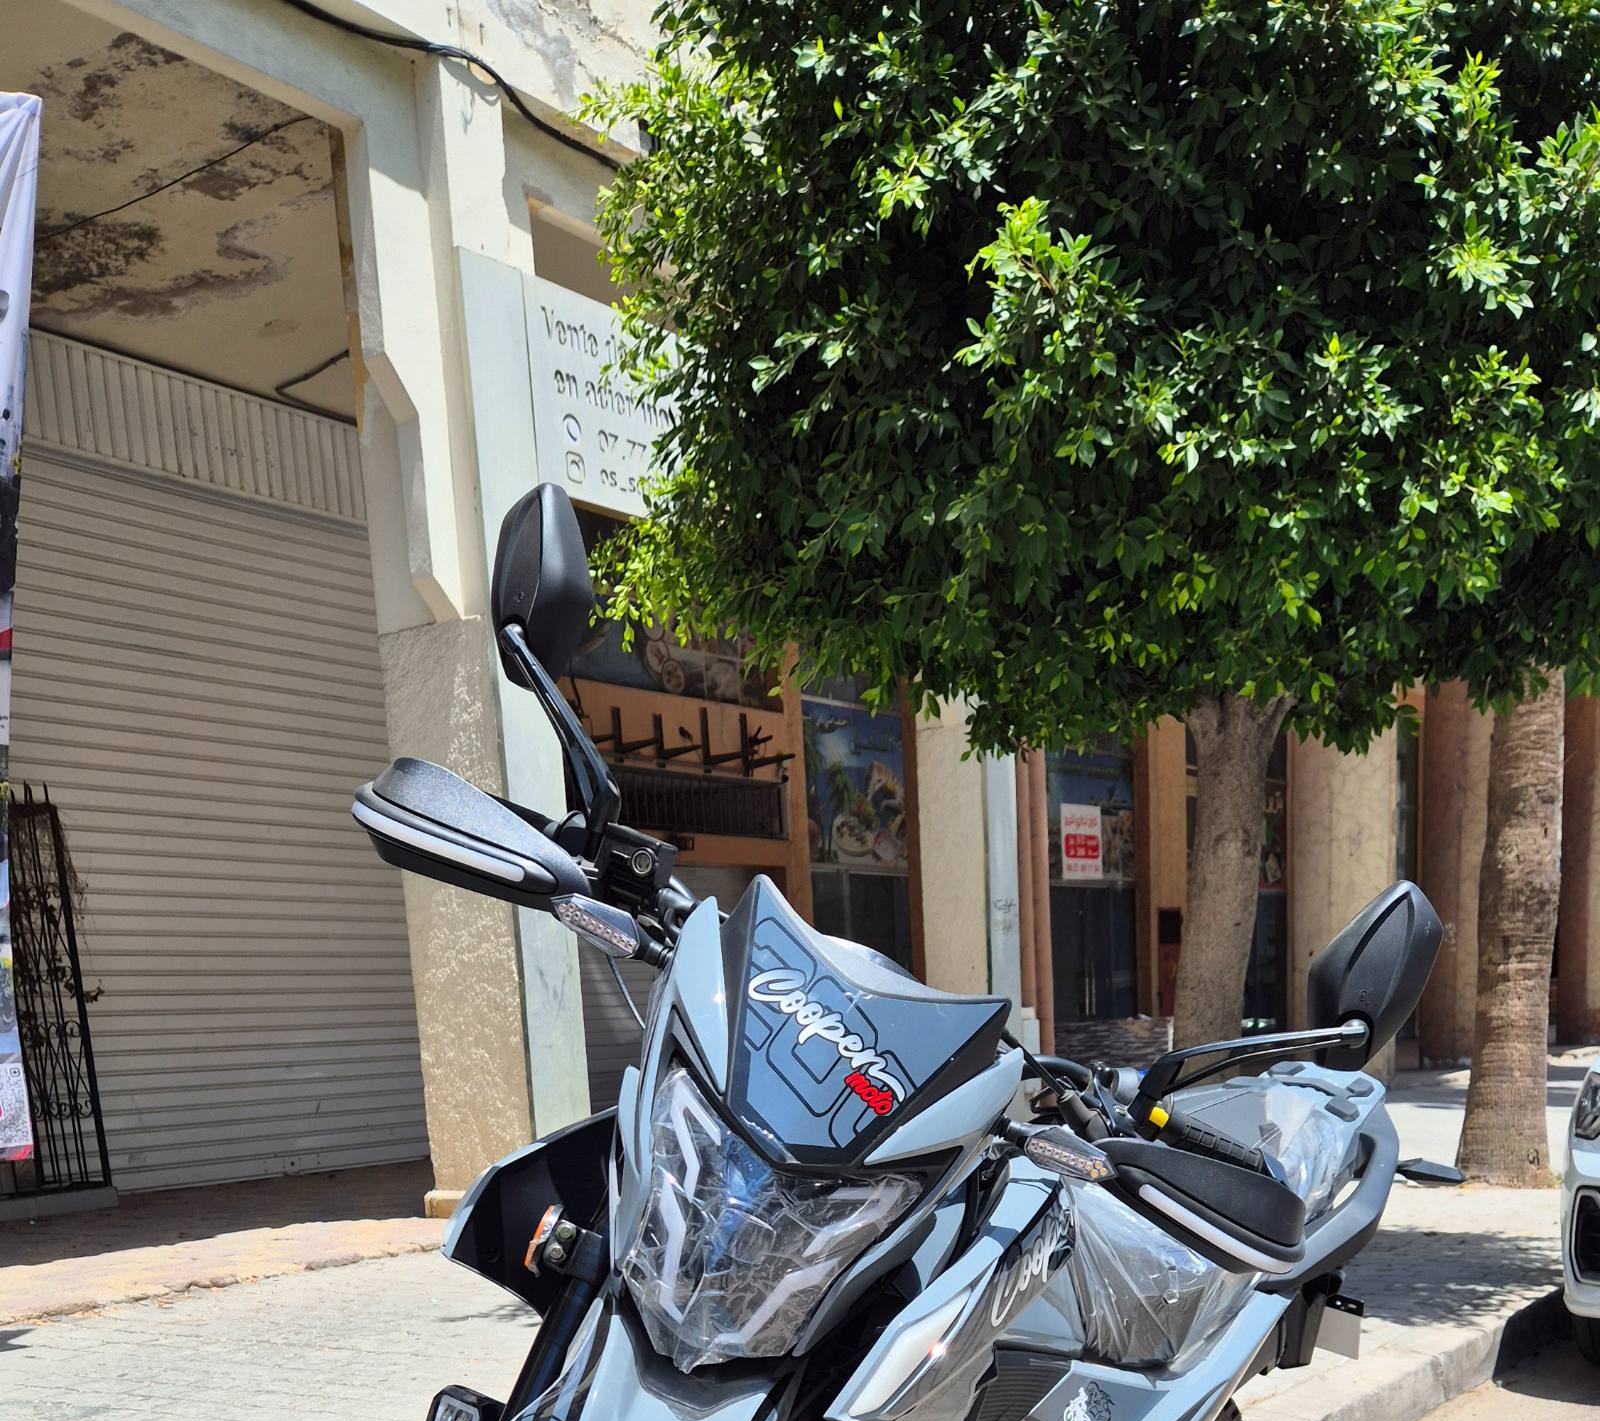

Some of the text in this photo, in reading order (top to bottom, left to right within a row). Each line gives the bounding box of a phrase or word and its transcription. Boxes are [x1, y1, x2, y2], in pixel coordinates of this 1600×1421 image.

[541, 306, 598, 357] Vente
[554, 369, 578, 399] en
[844, 1072, 895, 1116] moto
